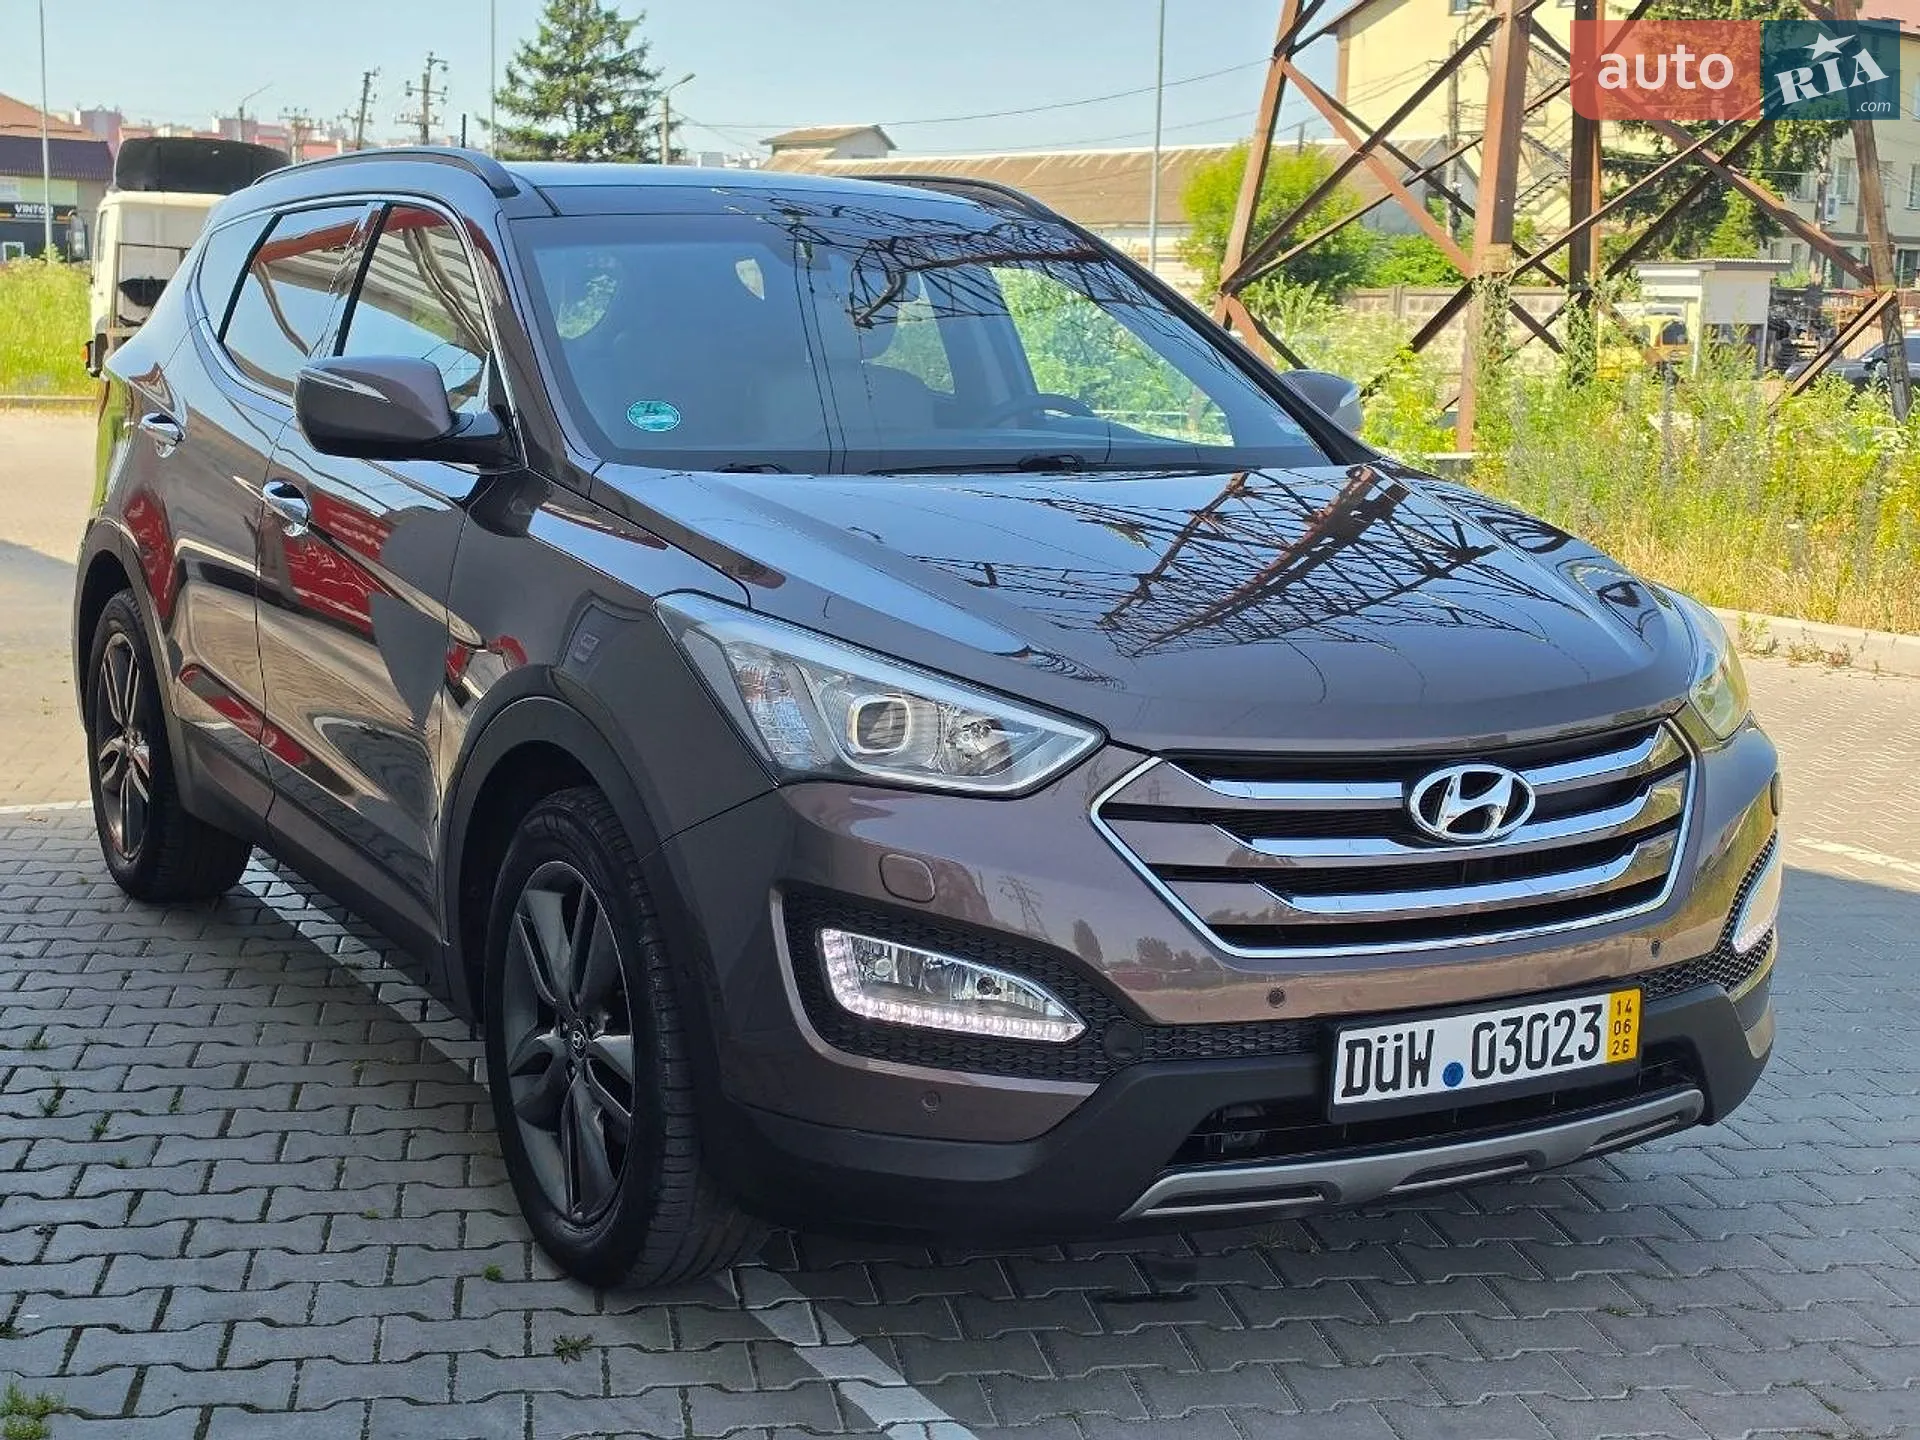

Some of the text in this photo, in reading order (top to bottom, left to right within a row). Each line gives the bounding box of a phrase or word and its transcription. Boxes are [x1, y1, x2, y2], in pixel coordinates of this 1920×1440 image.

[1616, 998, 1632, 1016] 14
[1613, 1018, 1632, 1036] 06
[1471, 1003, 1602, 1080] 03023
[1612, 1038, 1629, 1055] 26
